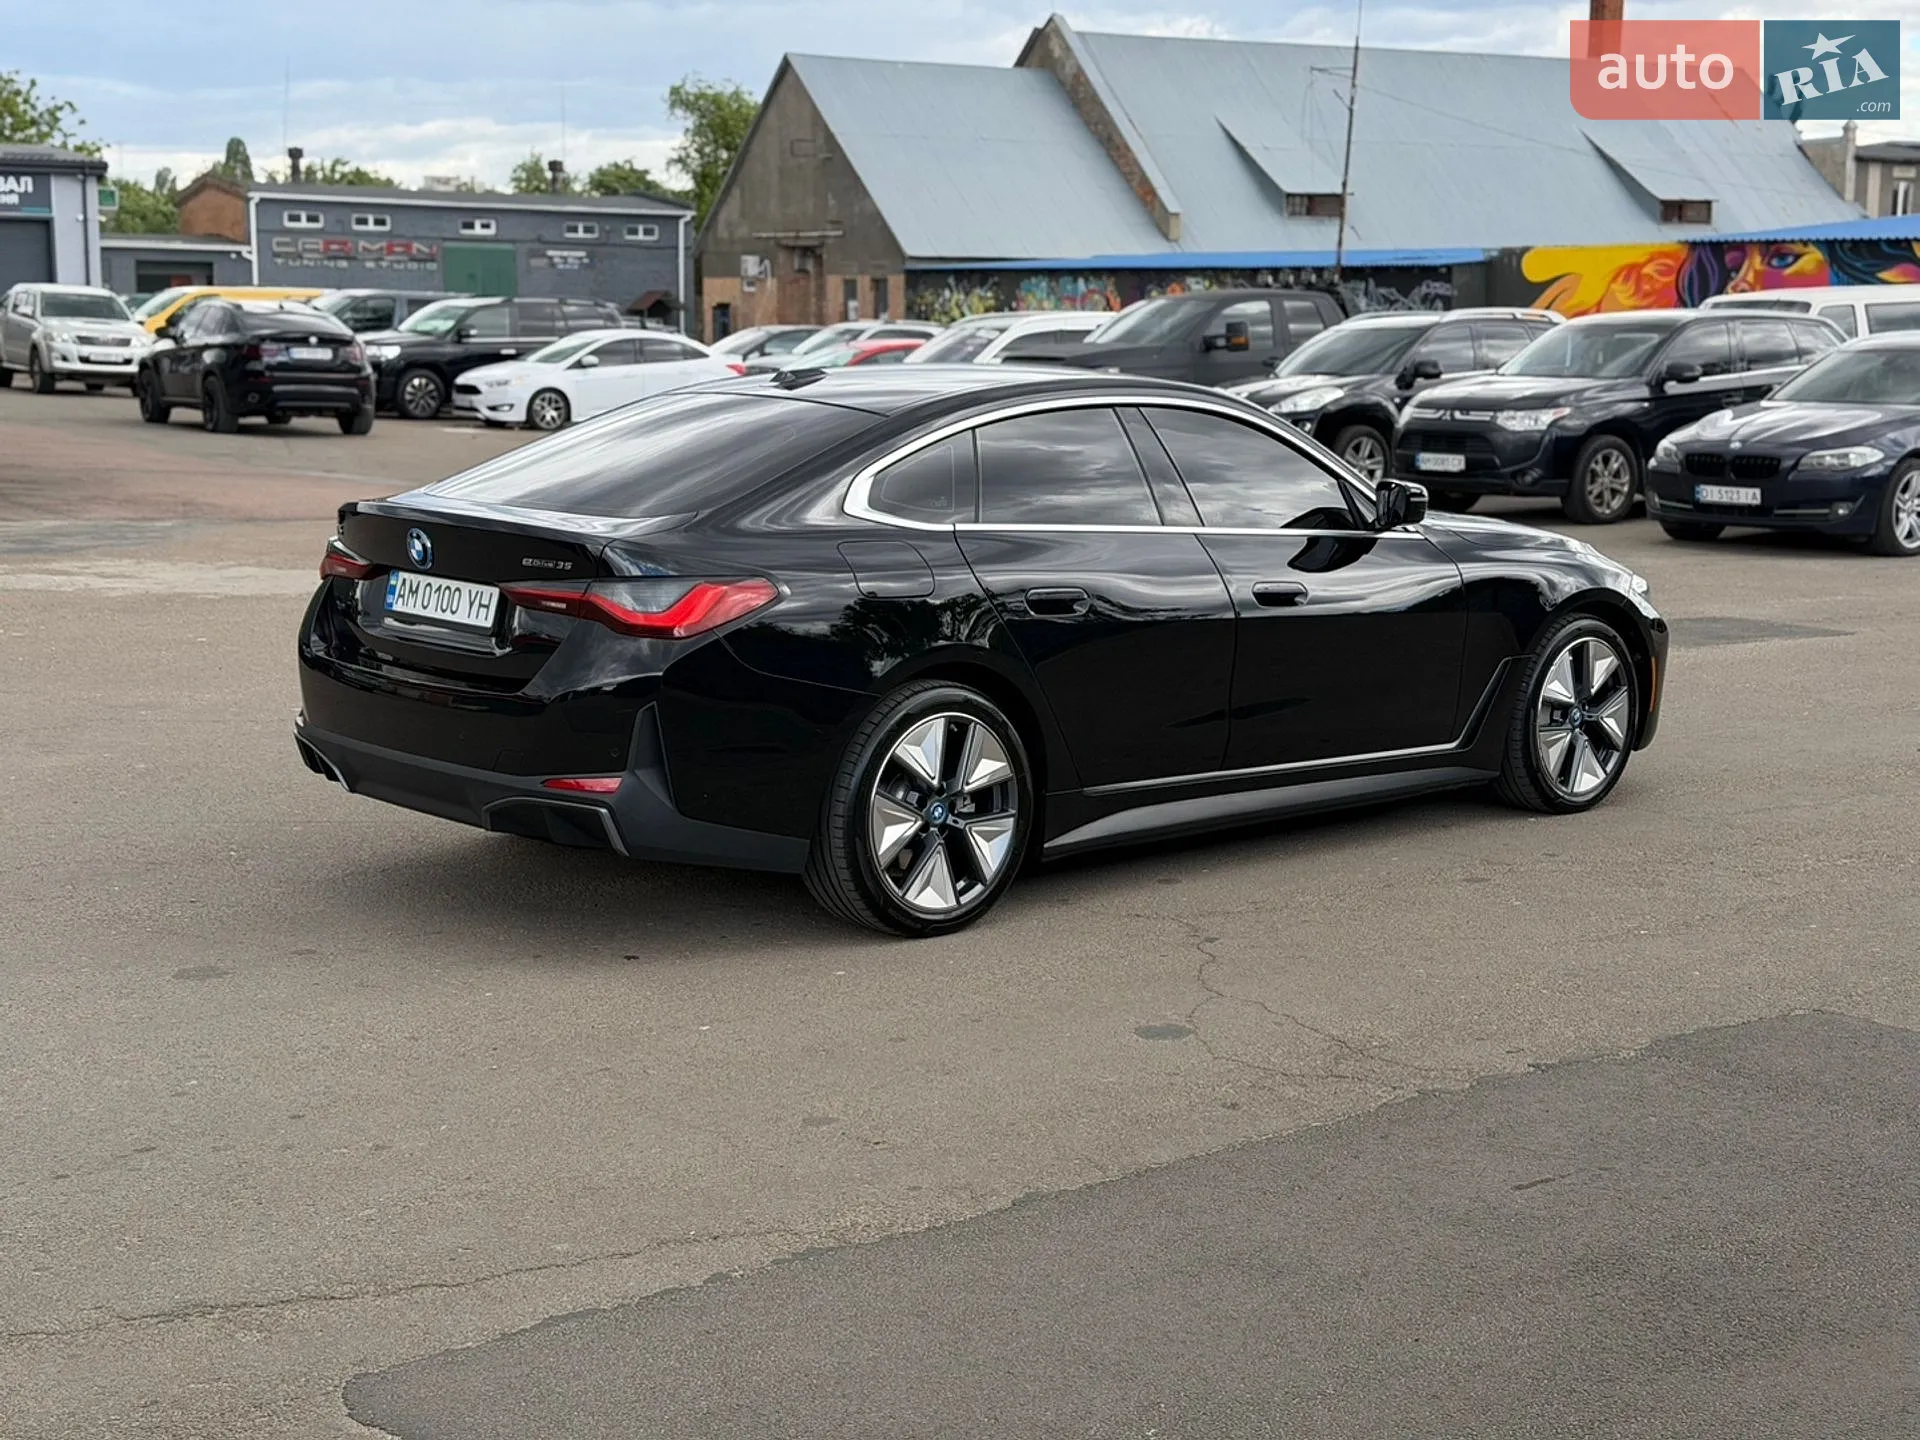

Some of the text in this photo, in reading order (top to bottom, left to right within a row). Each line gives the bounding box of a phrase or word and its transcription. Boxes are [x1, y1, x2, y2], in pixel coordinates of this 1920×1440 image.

[556, 560, 574, 571] 35
[395, 577, 493, 621] AM 0100 YH
